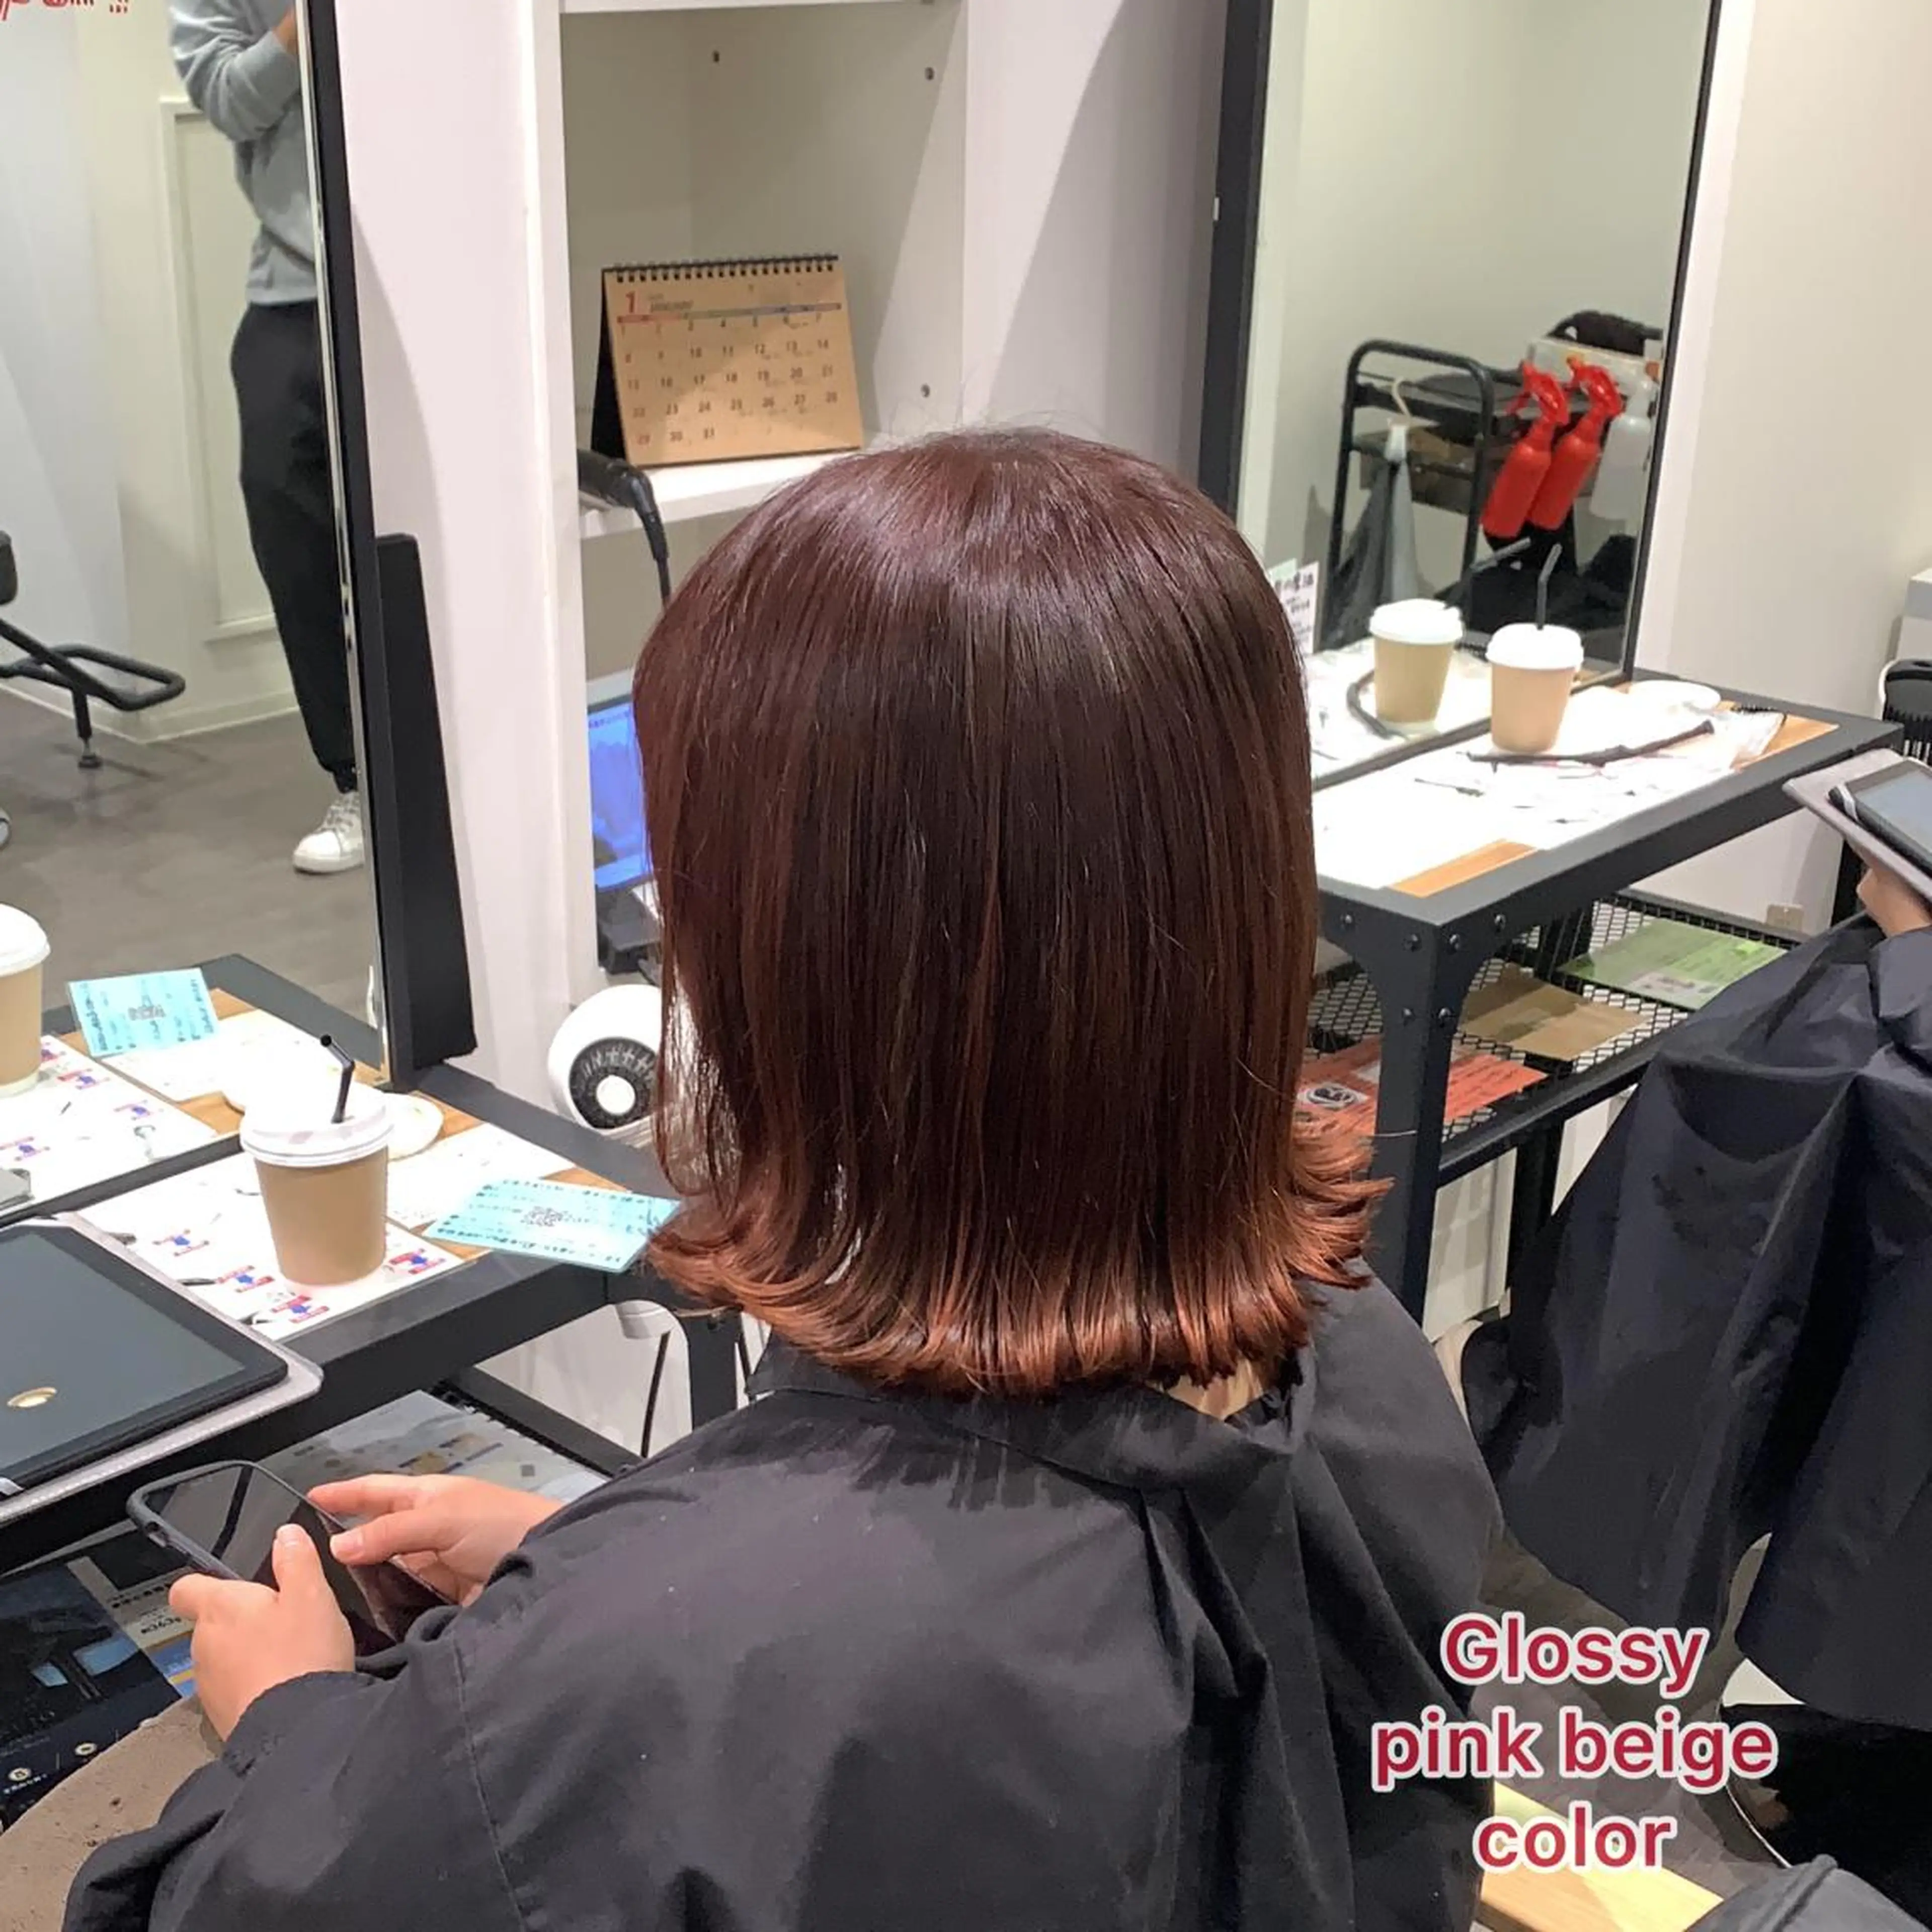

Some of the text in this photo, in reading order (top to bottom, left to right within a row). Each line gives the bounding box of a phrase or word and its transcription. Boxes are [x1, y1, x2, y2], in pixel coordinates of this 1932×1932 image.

[625, 290, 635, 313] 1
[755, 343, 765, 355] 12
[817, 339, 829, 350] 14
